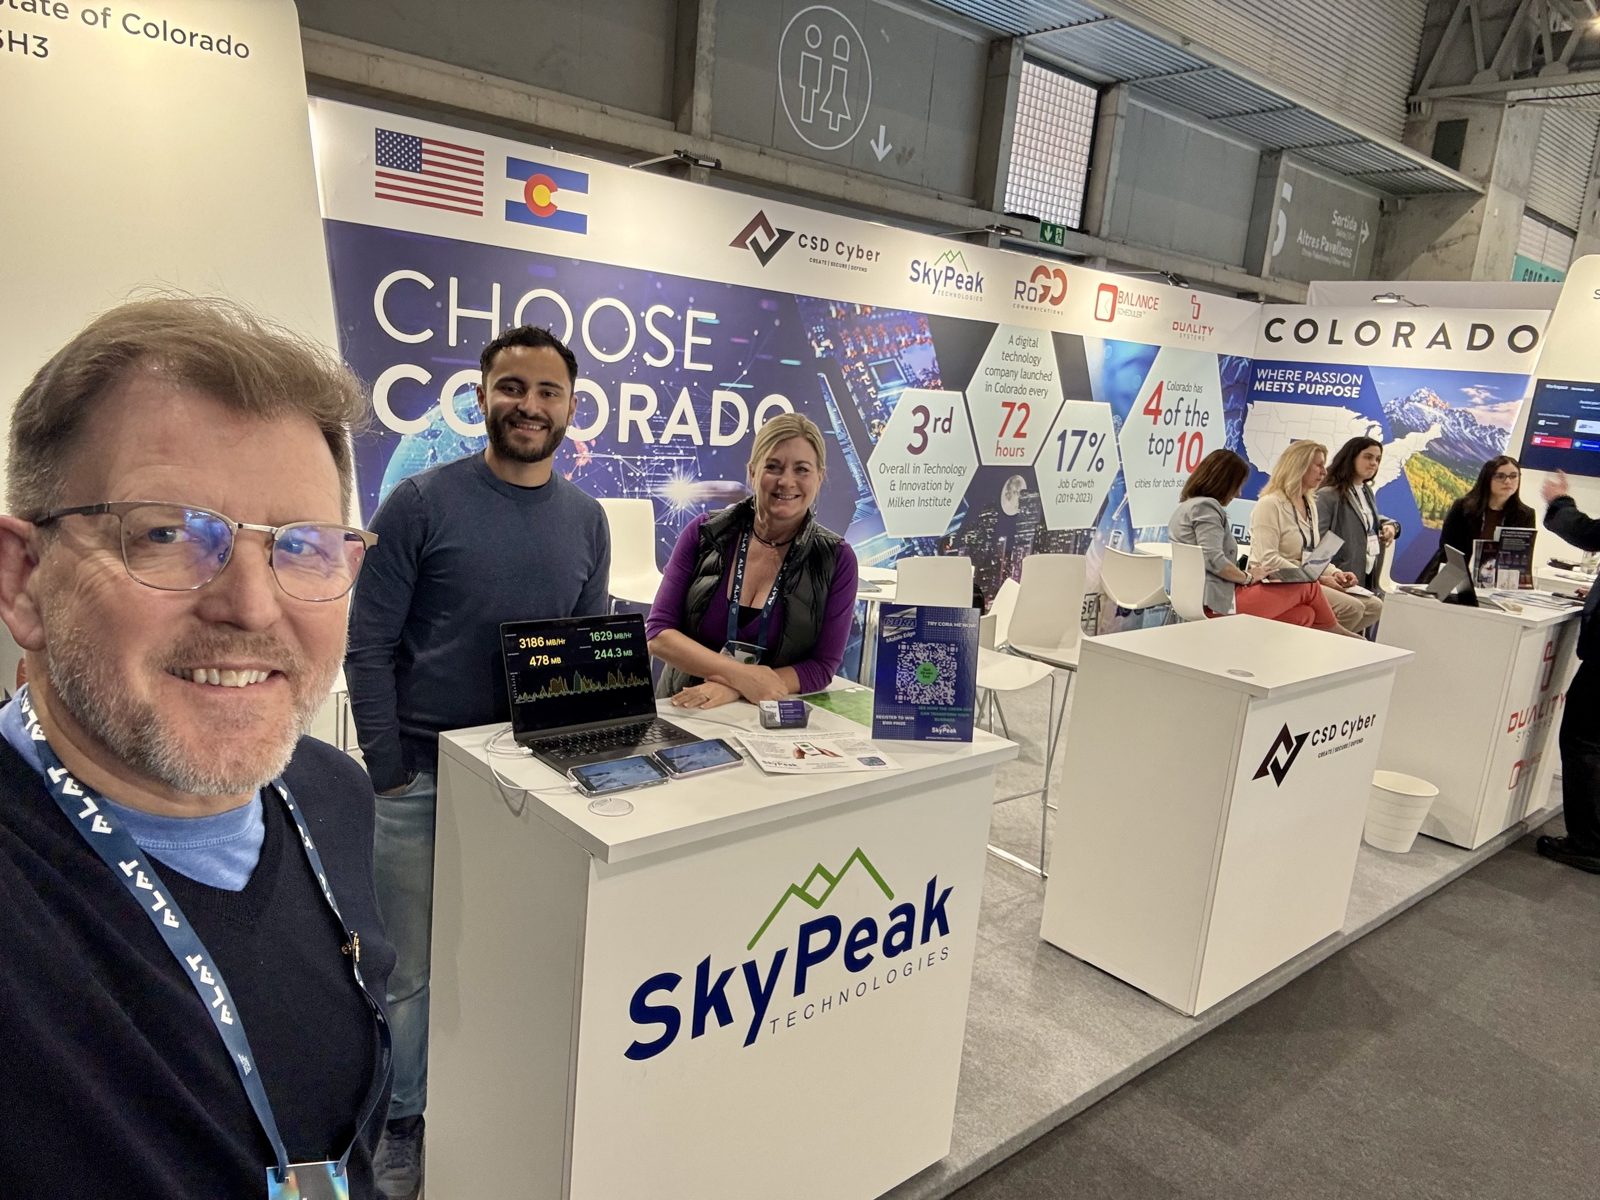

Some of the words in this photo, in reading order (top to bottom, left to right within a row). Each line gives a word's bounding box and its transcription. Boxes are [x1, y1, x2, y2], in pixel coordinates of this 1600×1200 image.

[0, 0, 69, 20] tate
[81, 7, 111, 29] of
[121, 13, 250, 59] Colorado
[0, 29, 49, 59] H3
[798, 233, 829, 252] CSD
[835, 241, 881, 262] Cyber
[909, 259, 985, 295] SkyPeak
[938, 289, 984, 302] TECHNOLOGIES
[1117, 290, 1160, 311] BALANCE
[373, 269, 717, 373] CHOOSE
[1172, 321, 1214, 336] DUALITY
[1008, 335, 1014, 345] A
[1015, 335, 1039, 349] digital
[1264, 317, 1540, 354] COLORADO
[1001, 351, 1042, 366] technology
[985, 367, 1018, 382] company
[1020, 367, 1052, 382] launched
[1256, 368, 1302, 382] WHERE
[1304, 371, 1363, 385] PASSION
[985, 382, 993, 392] in
[994, 382, 1028, 396] Colorado
[1029, 387, 1049, 399] every
[1166, 380, 1192, 393] Colorado
[1193, 382, 1203, 393] has
[1253, 381, 1295, 394] MEETS
[1297, 383, 1361, 398] PURPOSE
[372, 363, 796, 447] COORADO
[1142, 380, 1164, 425] 4
[1164, 397, 1184, 427] of
[1185, 398, 1209, 427] the
[998, 401, 1031, 439] 72
[906, 404, 954, 456] 3rd
[995, 440, 1025, 457] hours
[1056, 429, 1106, 472] 17%
[1148, 432, 1174, 467] top
[1175, 431, 1204, 473] 10
[879, 462, 910, 475] Overall
[913, 463, 921, 474] in
[924, 463, 967, 476] Technology
[889, 481, 896, 492] &
[899, 480, 942, 491] Innovation
[944, 481, 954, 492] by
[1058, 478, 1070, 489] Job
[1071, 478, 1095, 489] Growth
[1134, 478, 1151, 488] cities
[1152, 478, 1161, 488] for
[1163, 478, 1177, 488] tech
[887, 496, 915, 508] Milken
[917, 497, 952, 508] Institute
[1055, 493, 1093, 504] (2019-2023)
[519, 637, 545, 649] 3186
[545, 638, 566, 646] MB/Hr
[589, 630, 613, 642] 1629
[613, 632, 632, 640] MB/Hr
[529, 655, 549, 667] 478
[550, 656, 561, 664] MB
[594, 648, 622, 660] 244.3
[623, 649, 633, 657] MB
[931, 726, 957, 735] SkyPeak
[1311, 724, 1337, 746] CSD
[1341, 714, 1376, 740] Cyber
[47, 766, 112, 834] ALAT
[118, 859, 180, 928] ALAT
[624, 874, 955, 1061] SkyPeak
[185, 954, 234, 1025] ALAT
[769, 946, 950, 1035] TECHNOLOGIES
